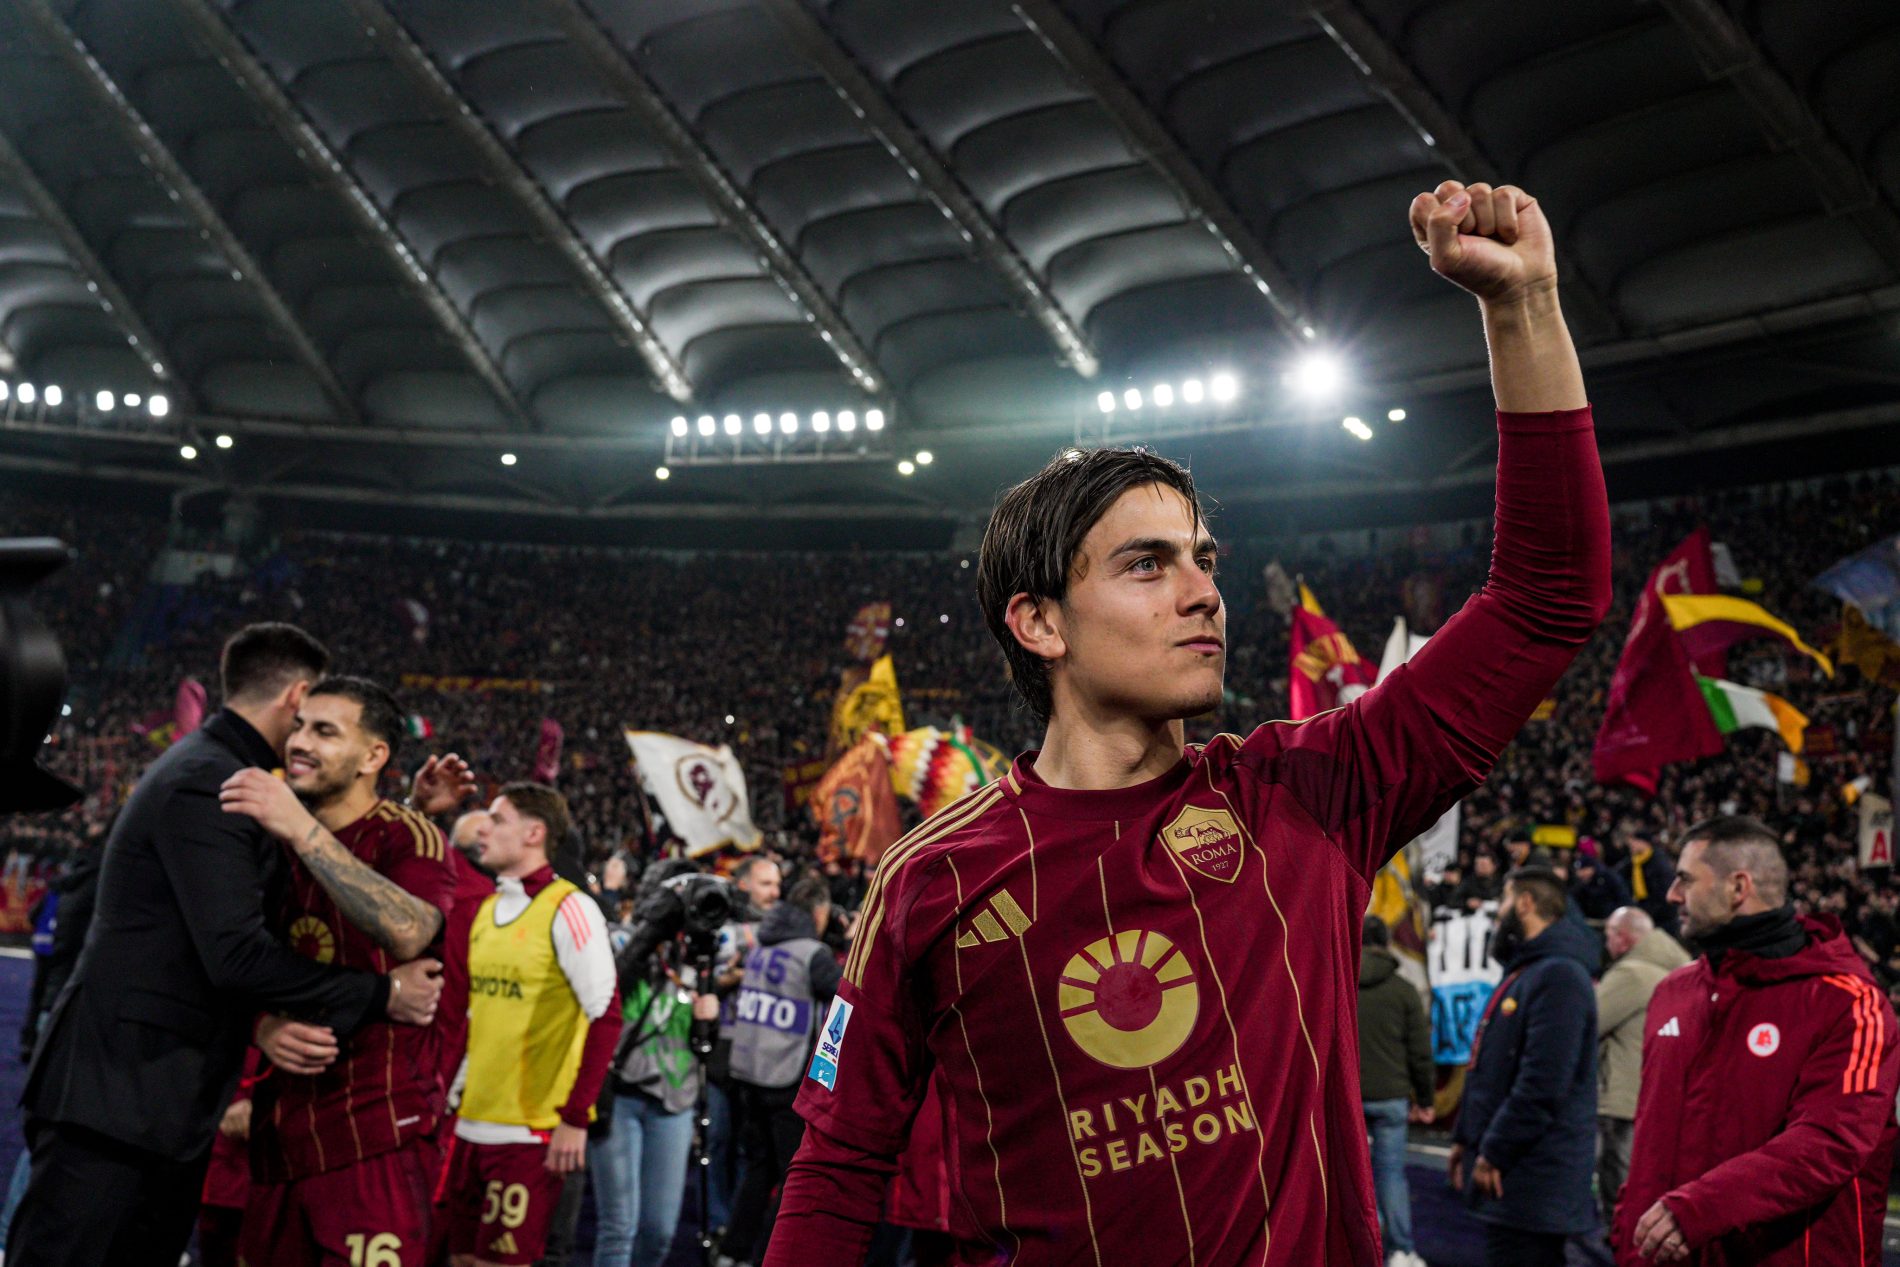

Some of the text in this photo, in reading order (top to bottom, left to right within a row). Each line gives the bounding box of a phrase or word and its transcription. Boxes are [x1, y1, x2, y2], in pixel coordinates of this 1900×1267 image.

[1191, 843, 1237, 865] ROMA
[1212, 861, 1229, 872] 1927
[470, 976, 524, 1000] OYOTA
[1069, 1064, 1242, 1140] RIYADH
[1079, 1101, 1254, 1177] SEASON
[481, 1180, 529, 1228] 59
[345, 1232, 402, 1267] 16
